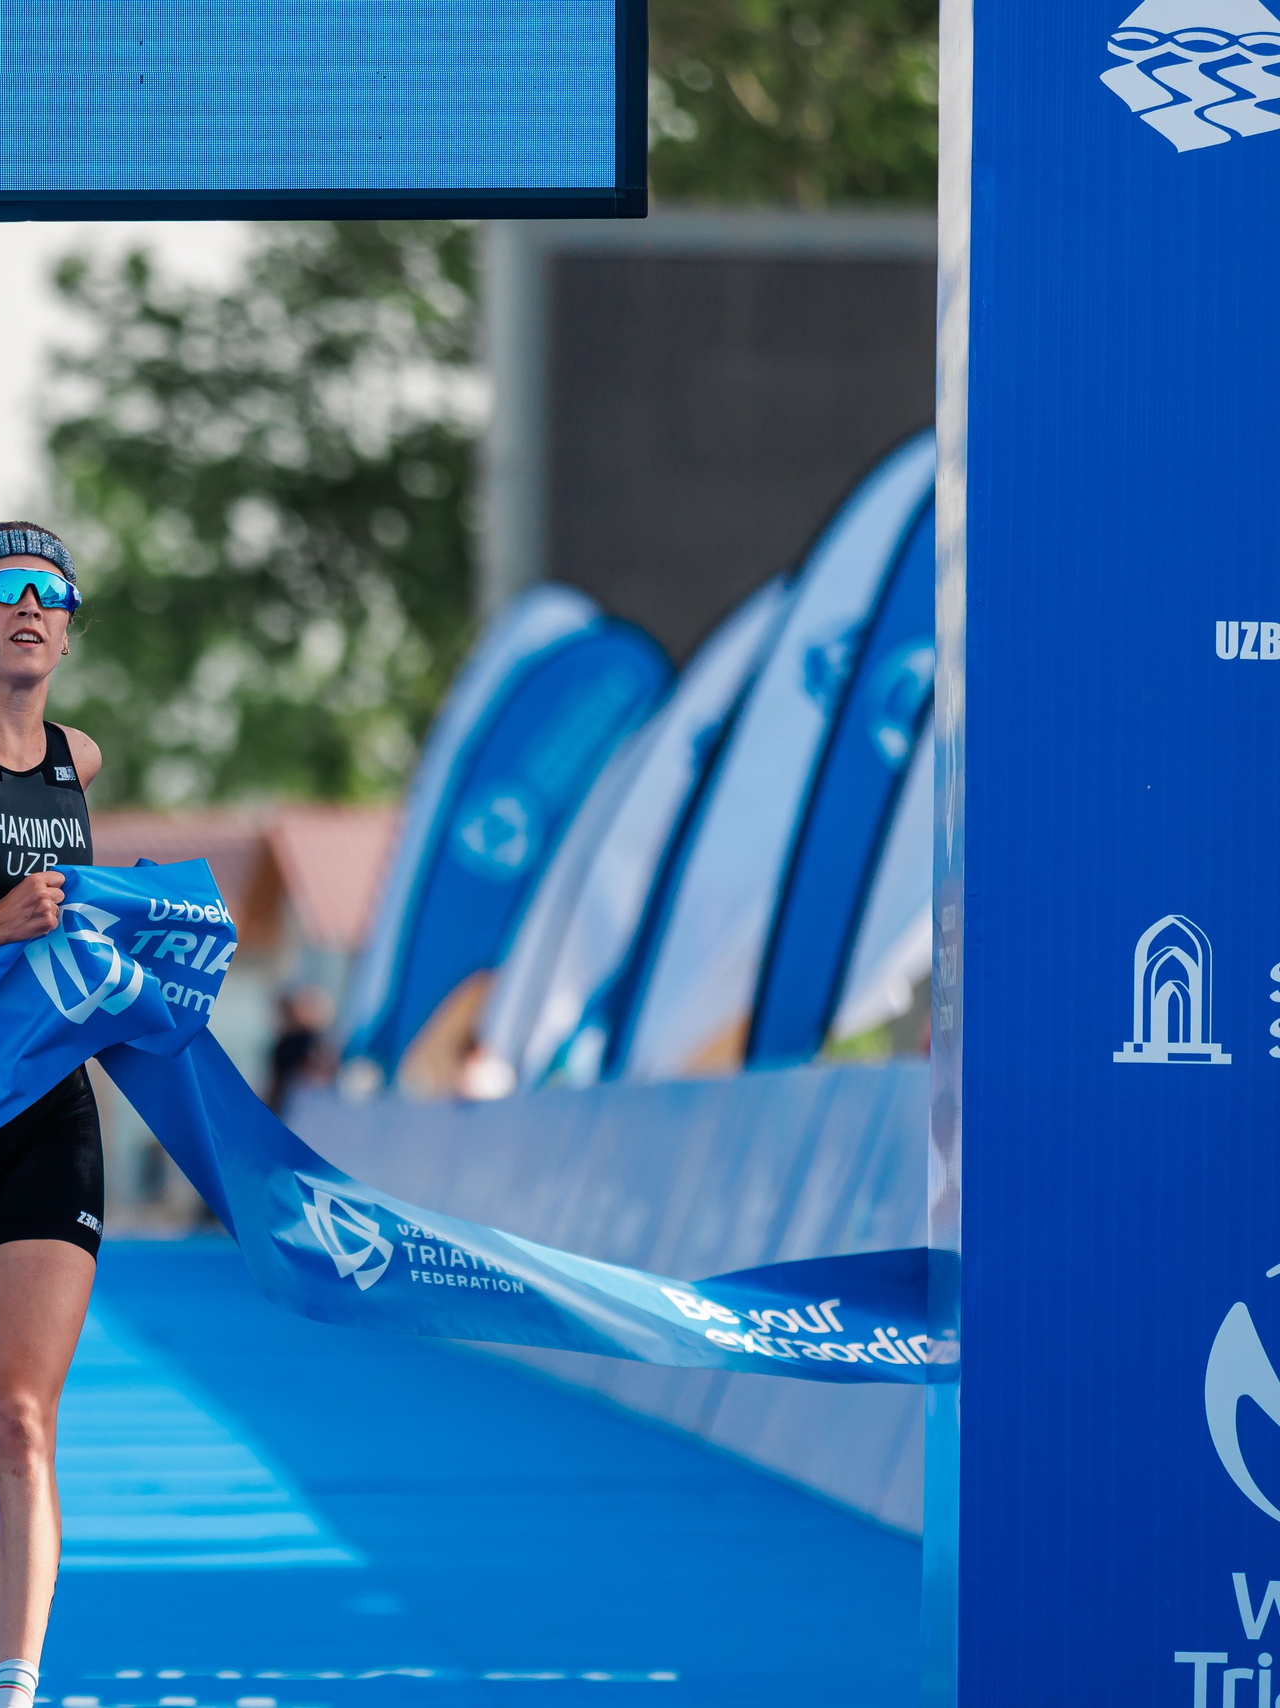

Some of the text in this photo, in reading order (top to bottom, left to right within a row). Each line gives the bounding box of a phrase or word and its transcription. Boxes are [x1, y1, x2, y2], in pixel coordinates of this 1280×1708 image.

[1215, 621, 1280, 660] UZB
[410, 1270, 524, 1295] FEDERATION
[660, 1286, 740, 1324] Be
[1174, 1652, 1280, 1708] Tri
